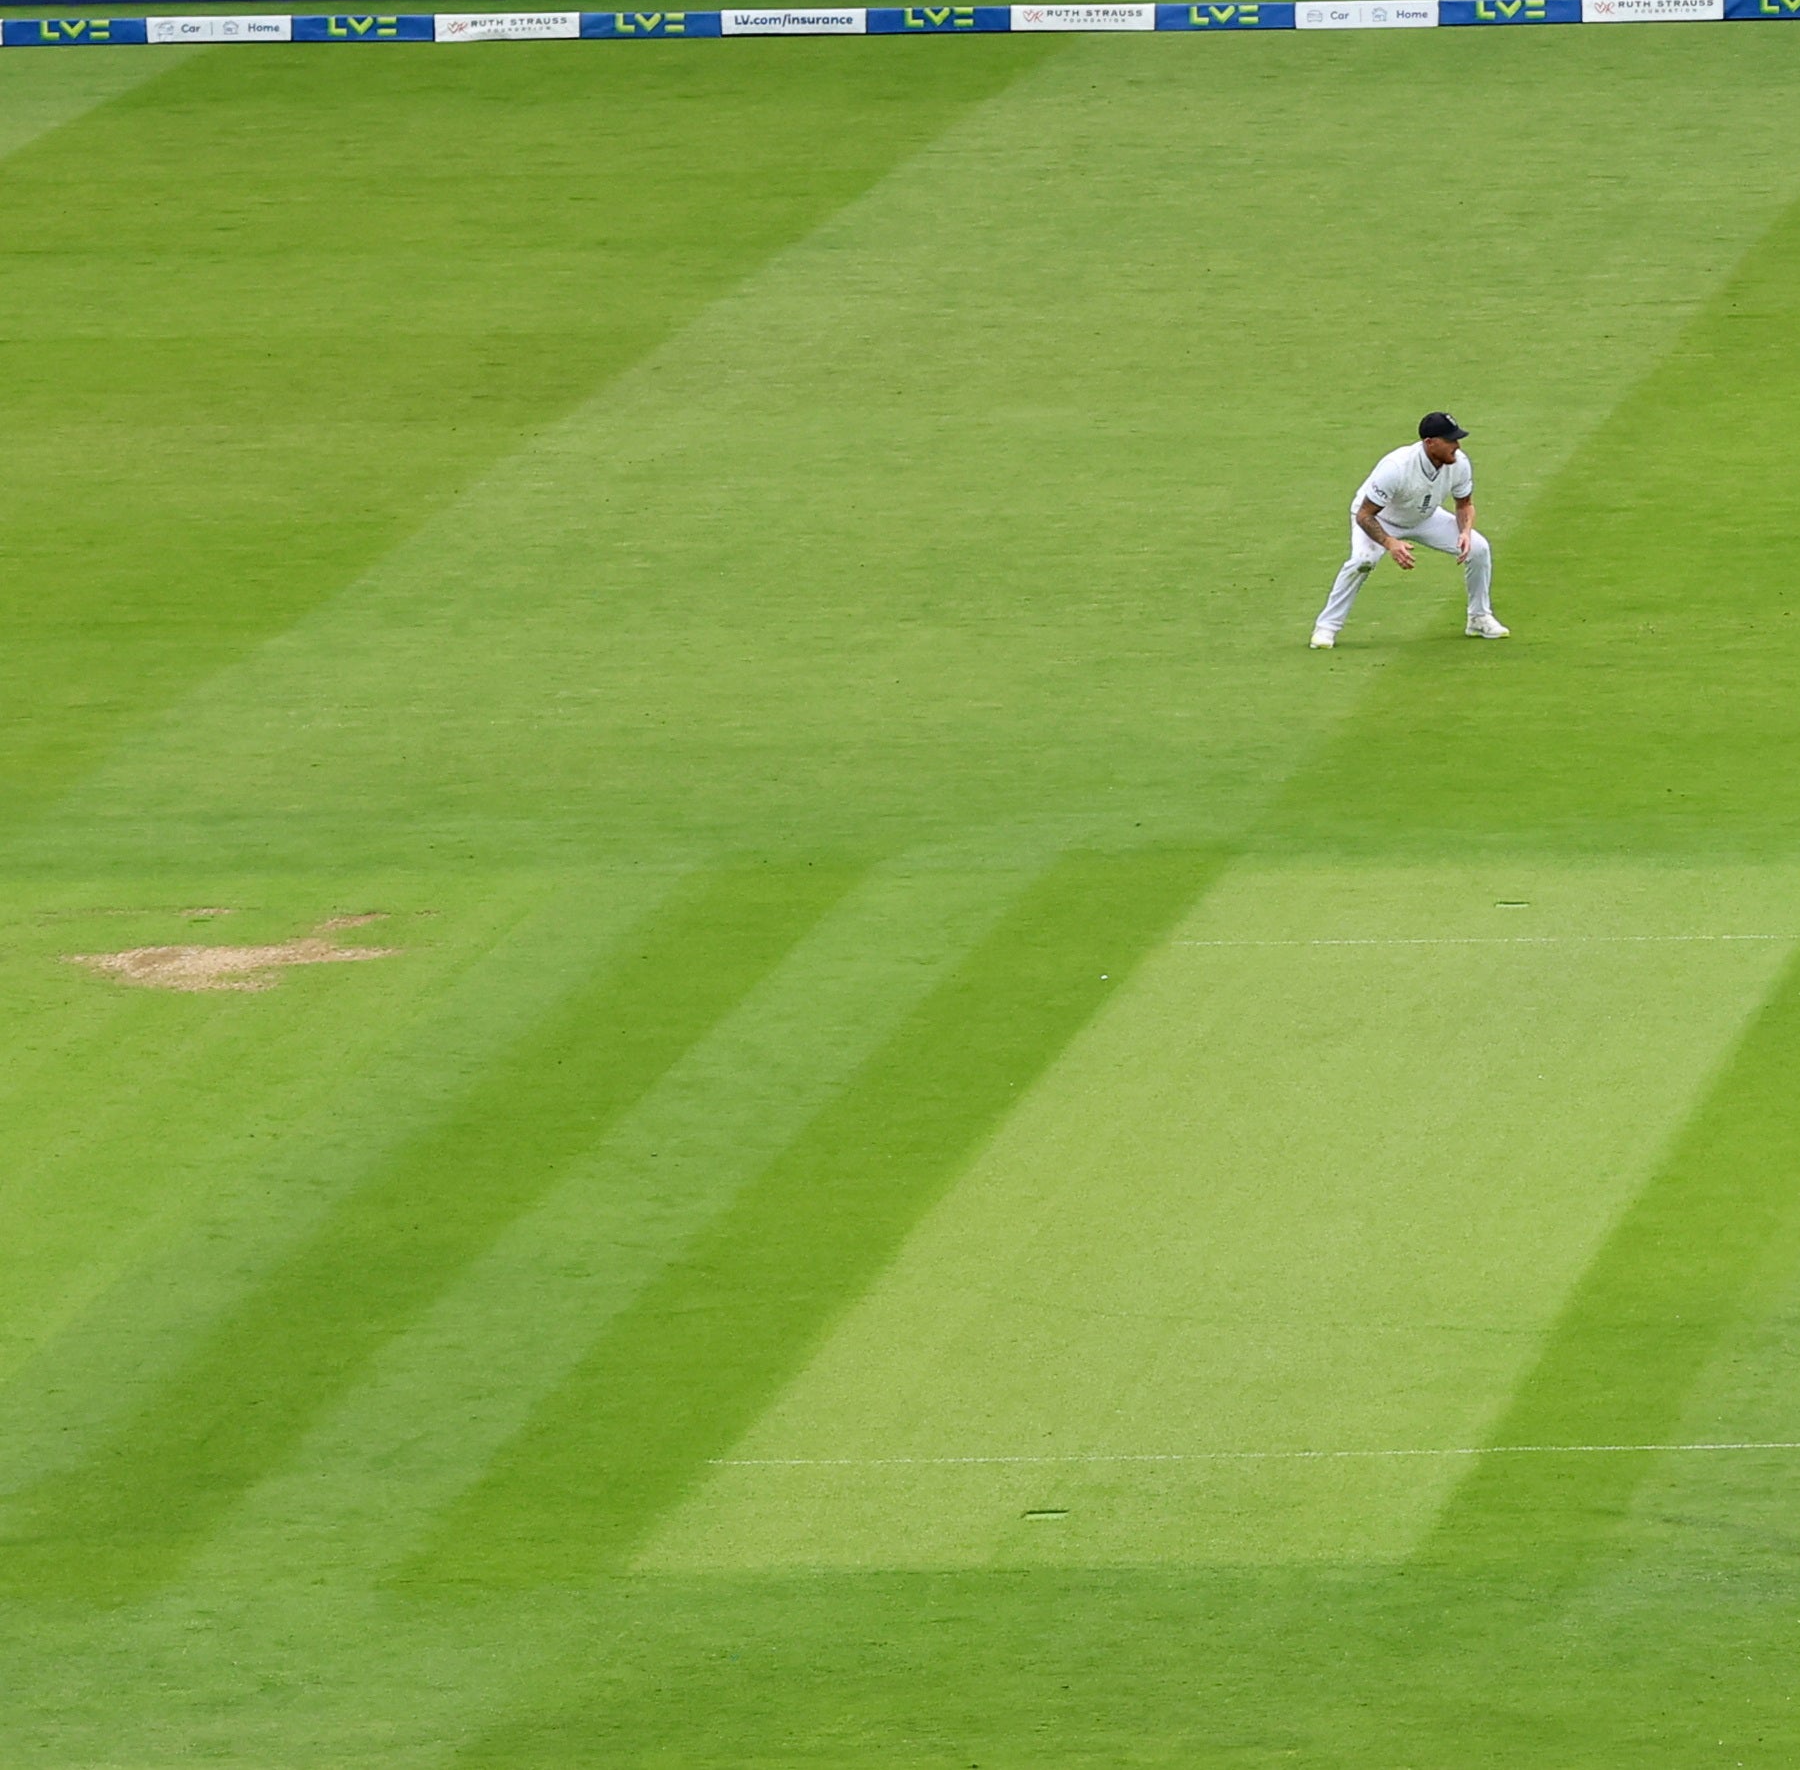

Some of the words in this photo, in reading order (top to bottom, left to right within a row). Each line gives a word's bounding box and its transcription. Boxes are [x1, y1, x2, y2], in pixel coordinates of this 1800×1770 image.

[1618, 0, 1654, 8] RUTH
[1658, 0, 1714, 8] STRAUSS
[1046, 9, 1084, 18] RUTH
[1086, 8, 1143, 17] STRAUSS
[1330, 10, 1349, 21] Car
[1396, 9, 1428, 20] Home
[470, 18, 507, 28] RUTH
[510, 17, 568, 26] STRAUSS
[734, 13, 853, 26] LV.com/insurance
[181, 23, 200, 33] Car
[248, 23, 280, 33] Home
